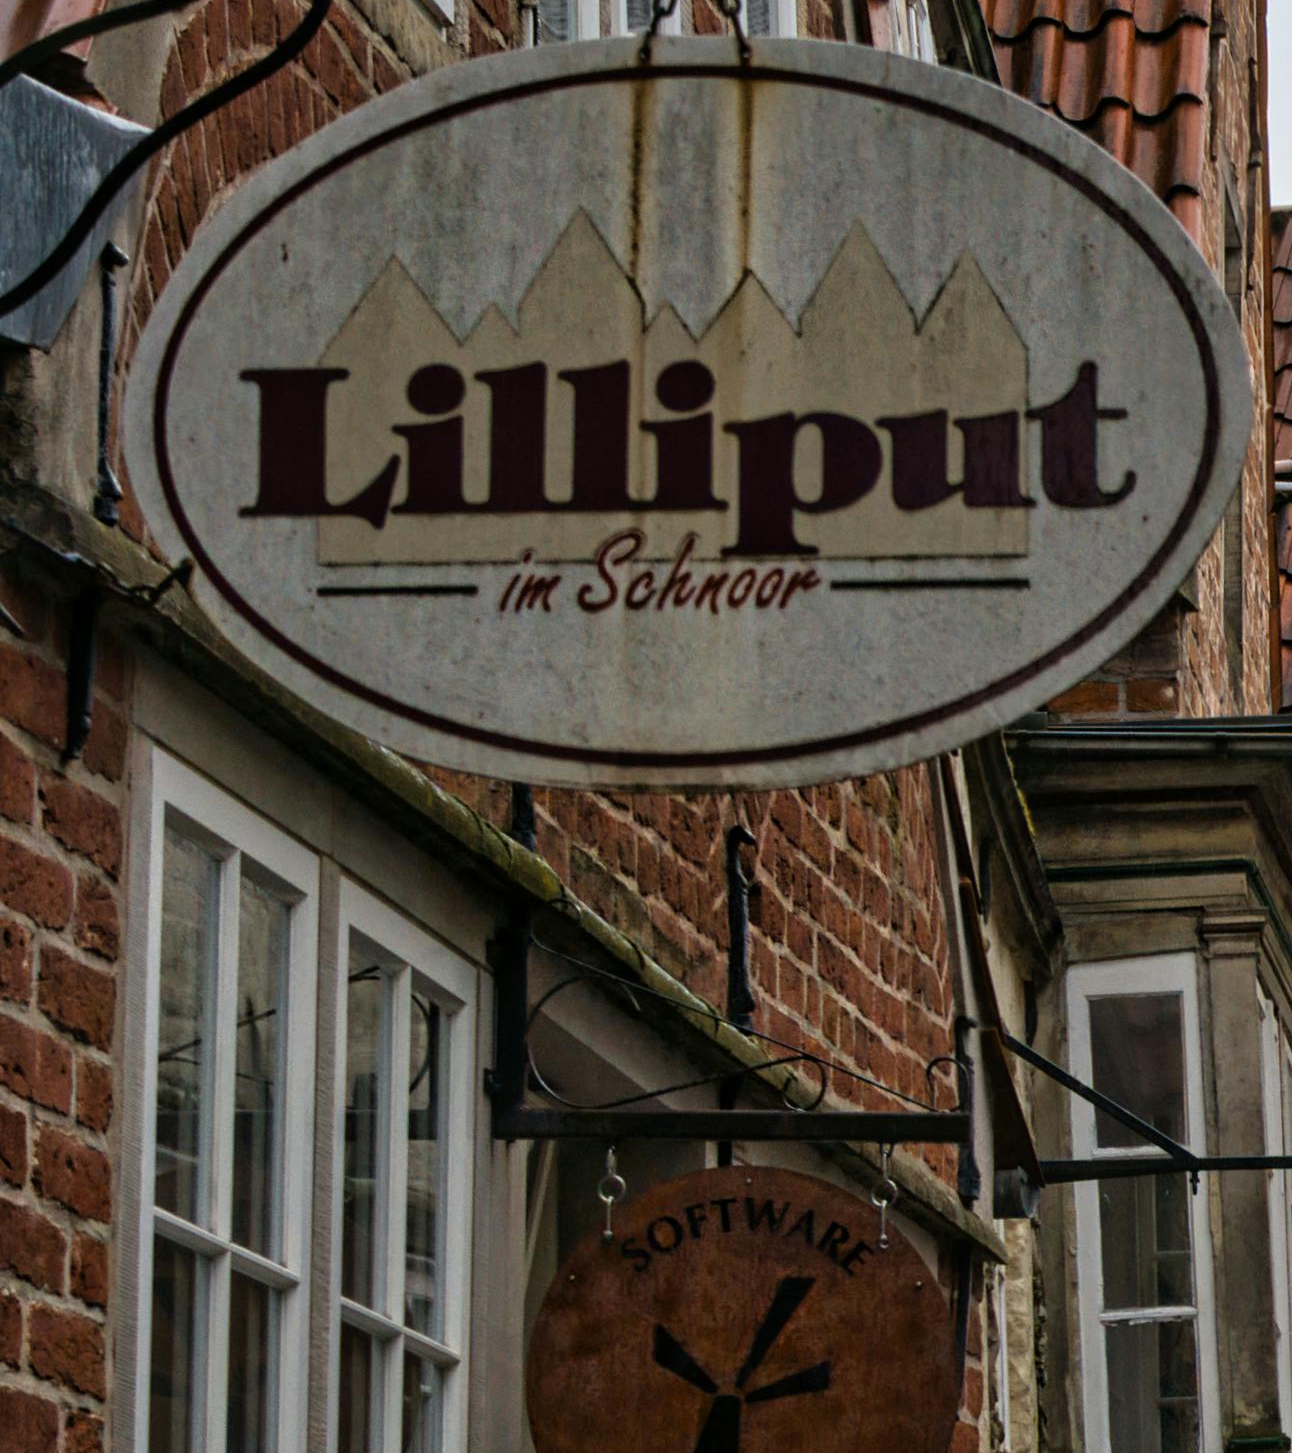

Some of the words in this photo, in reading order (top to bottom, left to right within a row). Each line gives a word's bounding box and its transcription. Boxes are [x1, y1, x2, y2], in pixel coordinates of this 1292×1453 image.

[238, 357, 1138, 559] Lilliput
[498, 547, 559, 616] im
[577, 525, 822, 616] Schnoor
[619, 1196, 878, 1276] SOFTWARE
